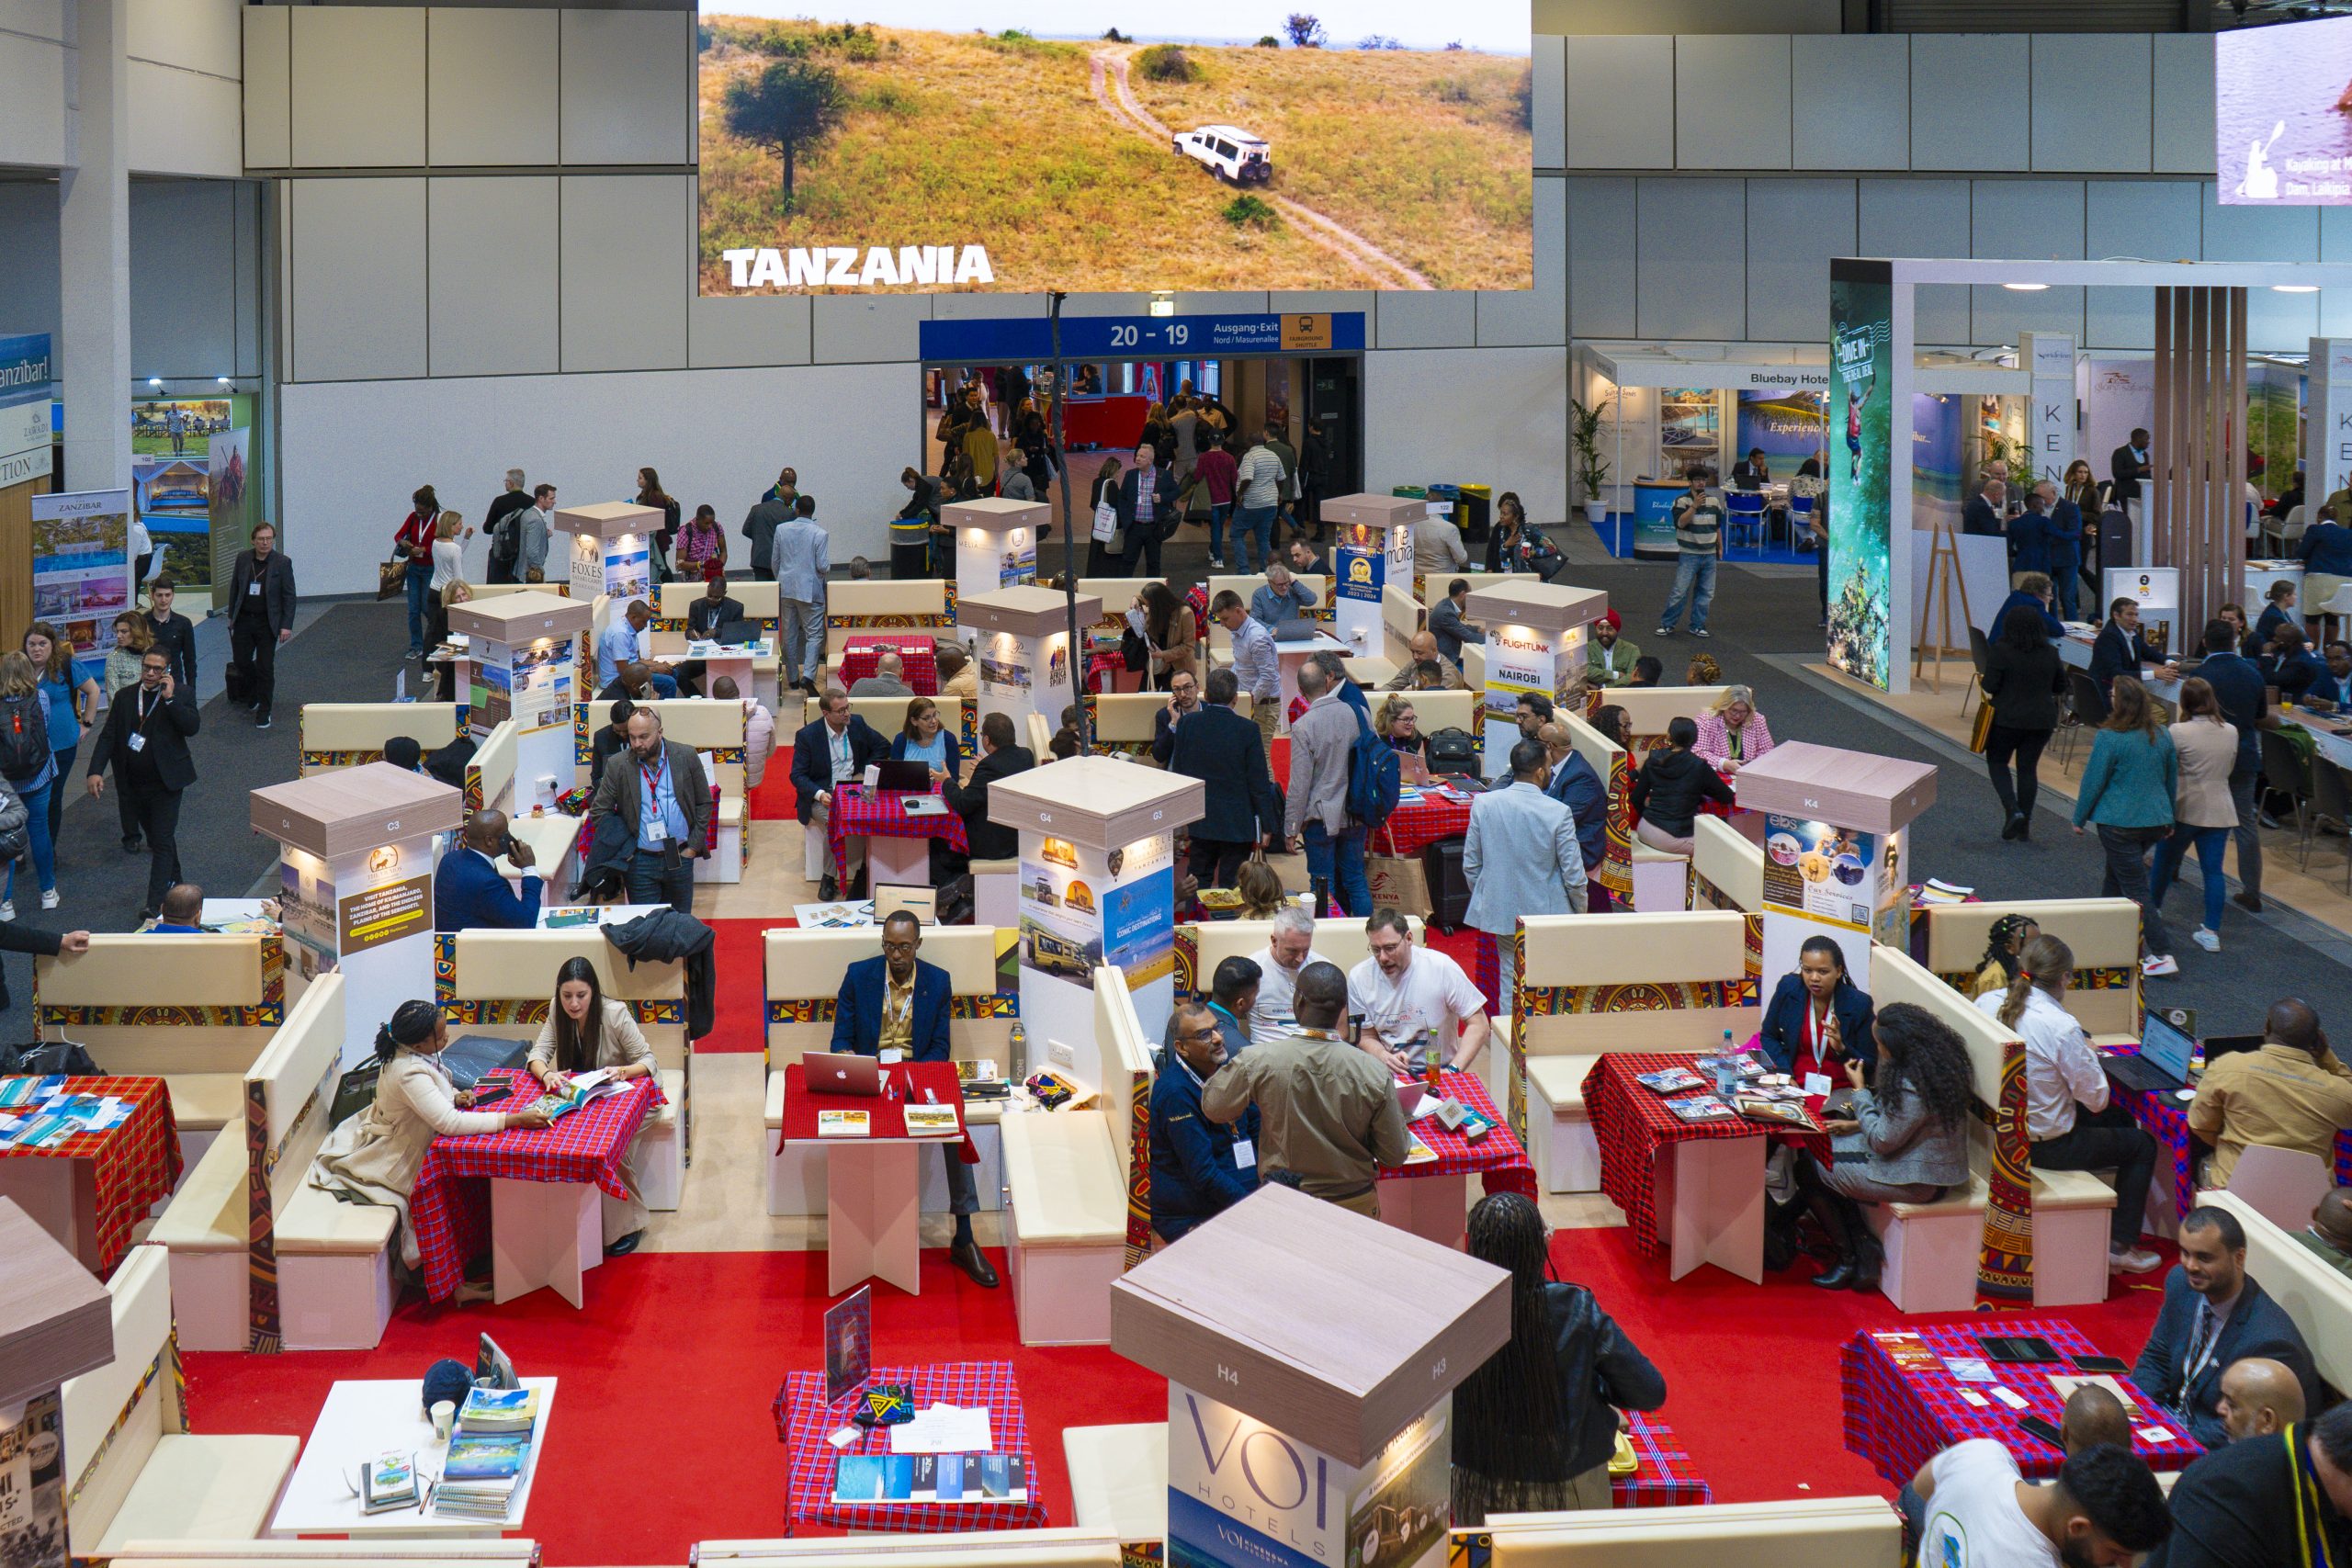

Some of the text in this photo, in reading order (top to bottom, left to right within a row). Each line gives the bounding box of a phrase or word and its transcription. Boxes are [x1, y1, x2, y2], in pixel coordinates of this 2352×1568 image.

[2286, 157, 2329, 174] Kayaking
[2329, 159, 2341, 171] at
[2286, 181, 2350, 197] Dam, Laikipia
[723, 244, 995, 288] TANZANIA
[1110, 325, 1138, 346] 20
[1165, 324, 1189, 345] 19
[1213, 335, 1230, 344] Nord
[1235, 334, 1279, 344] Masurenallee
[1841, 337, 1867, 364] DIVE IN
[1751, 374, 1828, 385] Bluebay Hote
[1841, 363, 1874, 384] THE REAL DEAL
[1770, 422, 1821, 434] Experienc
[59, 502, 102, 513] ZANZIBAR
[1391, 528, 1409, 547] the
[1385, 545, 1413, 567] mora
[571, 561, 603, 579] FOXES
[70, 613, 96, 621] AUTHENTIC
[1503, 638, 1550, 654] FLIGHTLINK
[1049, 669, 1066, 680] AFRICA
[1498, 669, 1541, 684] NAIROBI
[1049, 679, 1066, 687] SPIRIT
[1804, 798, 1819, 809] K4
[1040, 813, 1052, 823] G4
[1153, 810, 1162, 820] G3
[283, 819, 290, 829] C4
[387, 821, 400, 832] C3
[349, 904, 360, 913] THE
[360, 902, 377, 911] HOME
[384, 887, 423, 903] KILIMANJARO,
[364, 886, 408, 902] VISIT TANZANIA,
[1825, 888, 1853, 900] Services
[349, 908, 379, 920] ZANZIBAR,
[391, 901, 401, 909] THE
[401, 895, 423, 906] ENDLESS
[353, 917, 373, 926] PLAINS
[391, 902, 420, 915] SERENGETI.
[1116, 922, 1132, 939] ICONIC
[1132, 913, 1162, 932] DESTINATIONS
[1216, 1363, 1239, 1386] H4
[1432, 1358, 1447, 1380] H3
[1185, 1392, 1327, 1529] VOI
[1198, 1481, 1327, 1558] HOTELS
[1218, 1523, 1243, 1550] VOI
